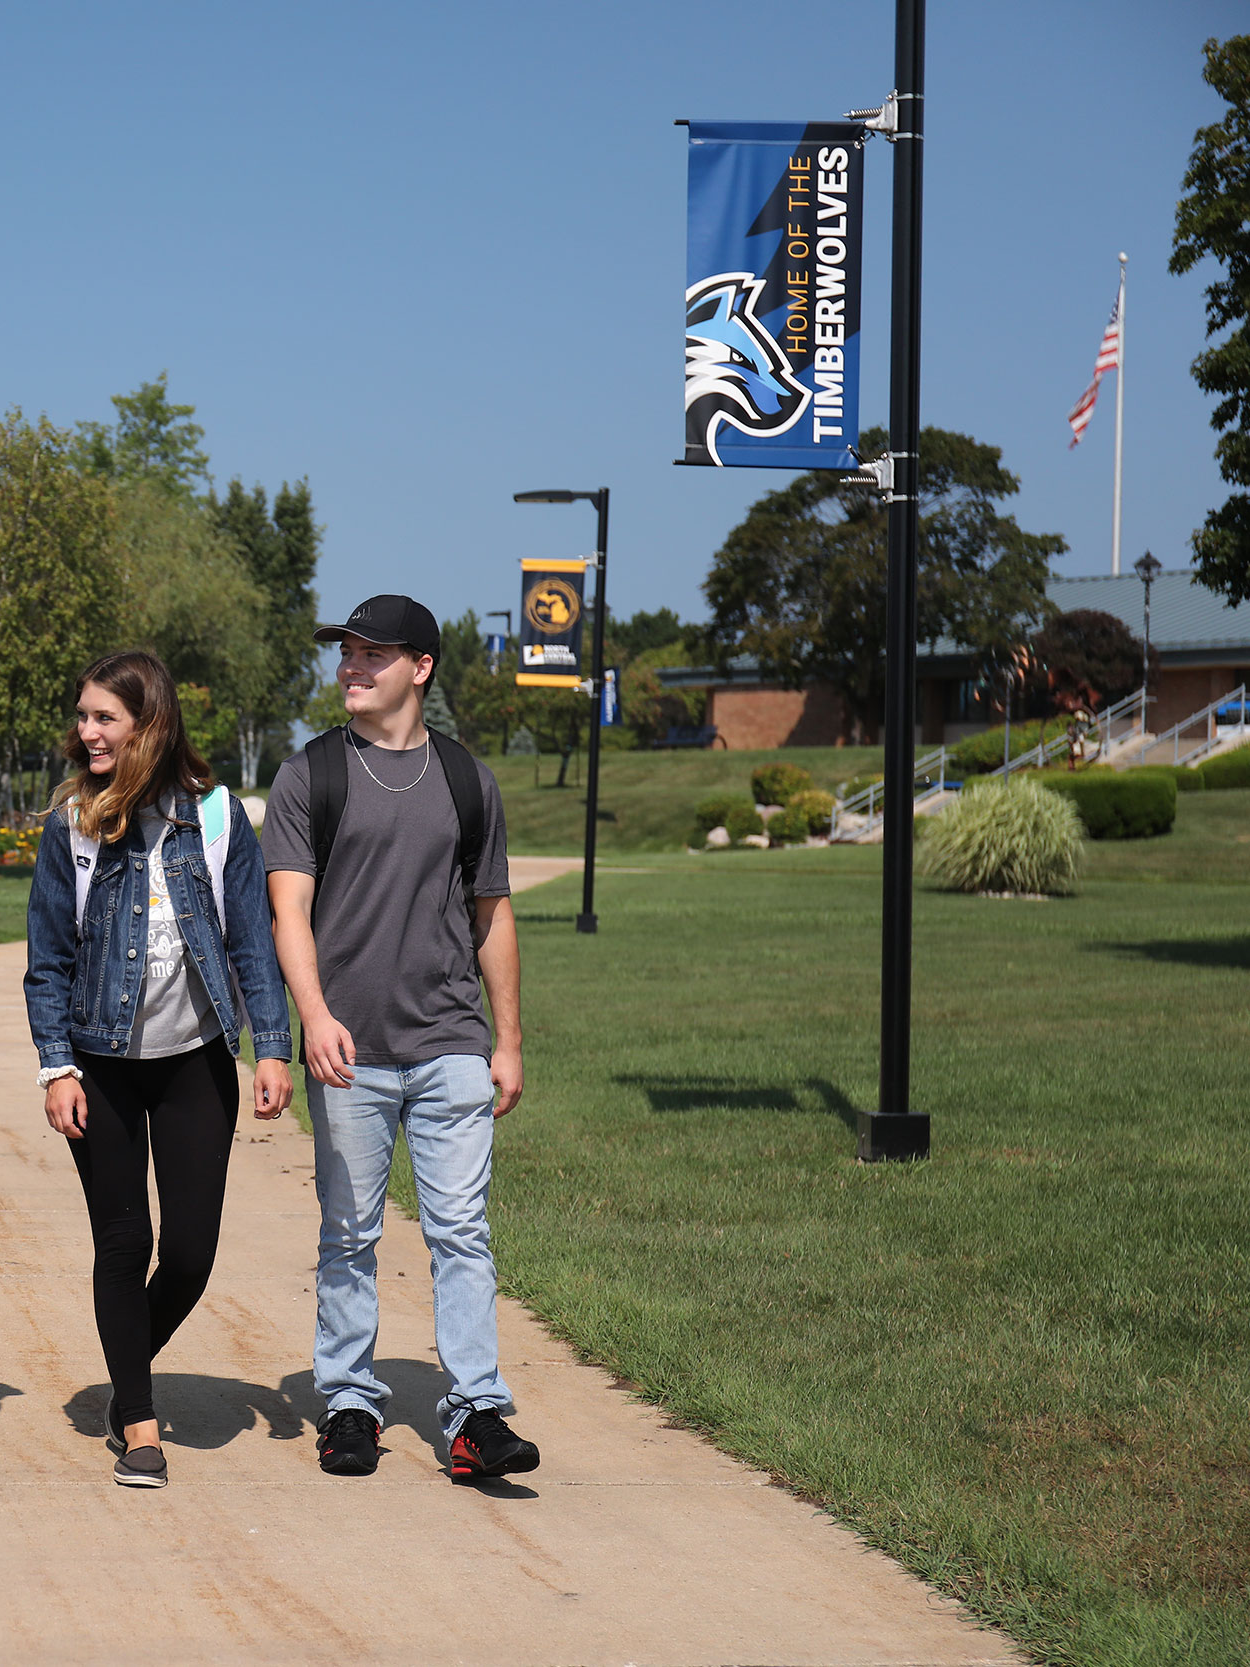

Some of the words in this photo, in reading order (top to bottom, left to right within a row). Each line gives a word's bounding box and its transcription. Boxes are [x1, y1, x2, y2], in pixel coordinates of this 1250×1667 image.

[788, 156, 811, 212] THE
[787, 222, 810, 258] OF
[786, 270, 809, 353] HOME
[813, 146, 849, 444] TIMBERWOLVES
